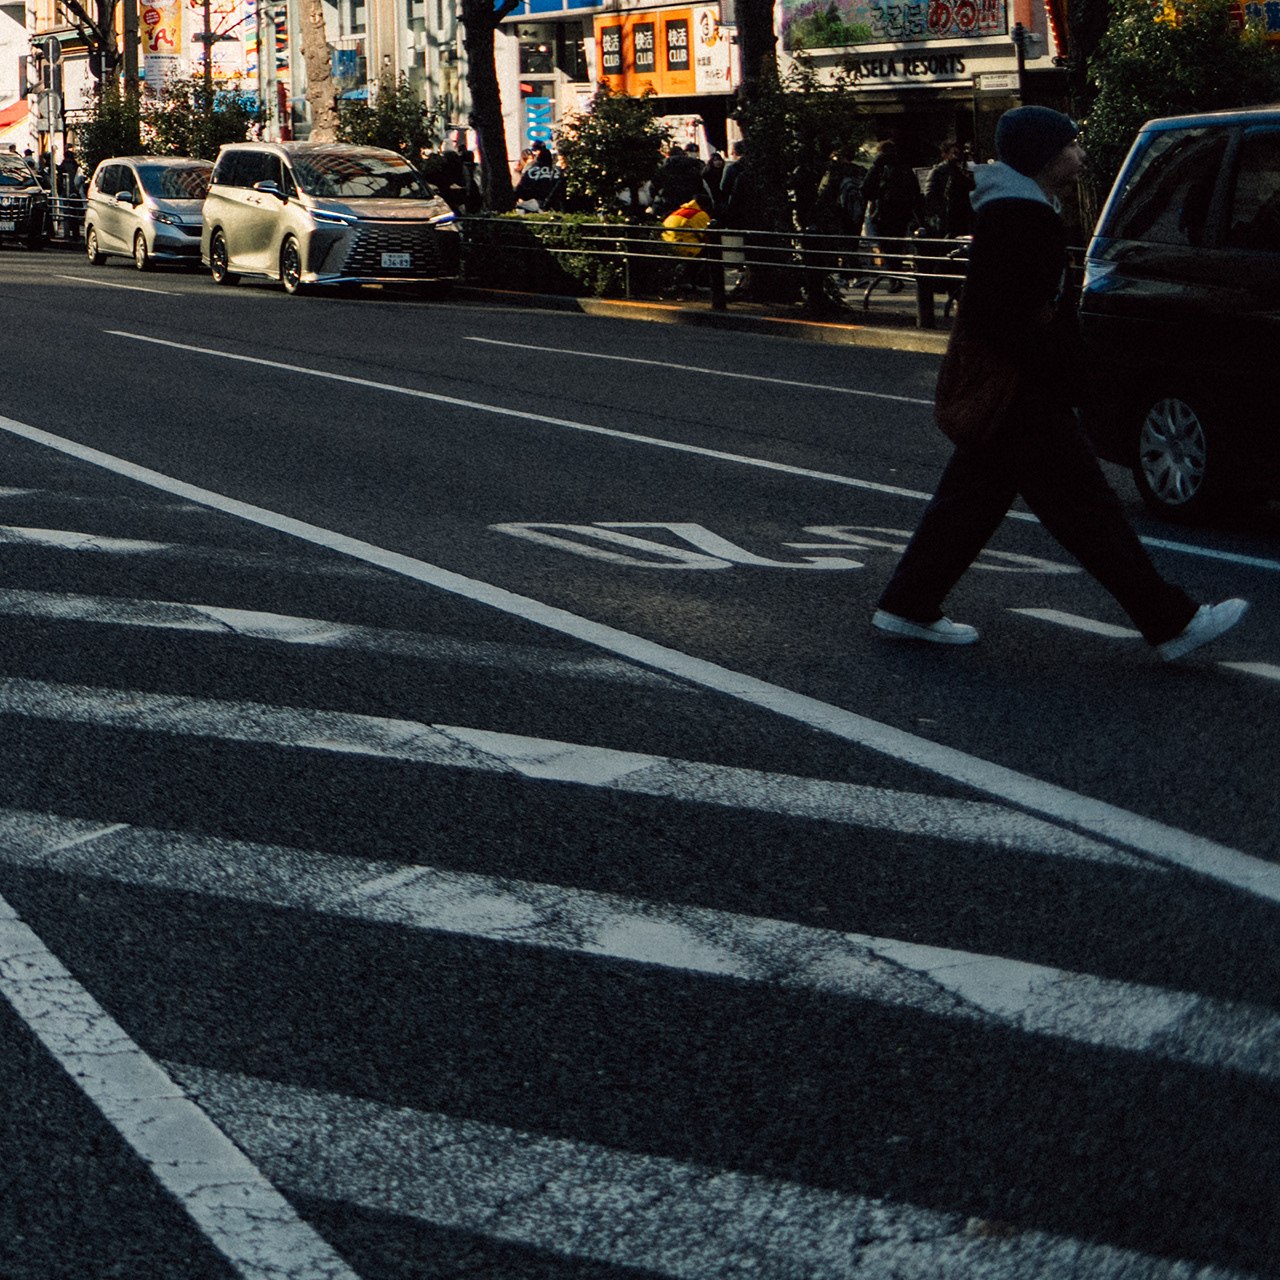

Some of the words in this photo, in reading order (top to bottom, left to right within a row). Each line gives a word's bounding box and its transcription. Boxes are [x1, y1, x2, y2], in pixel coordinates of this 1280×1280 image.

[603, 33, 620, 52] 快活
[635, 31, 654, 50] 快活
[667, 27, 687, 47] 快活
[603, 53, 620, 68] CLUB
[635, 51, 654, 65] CLUB
[668, 48, 688, 63] CLUB
[903, 53, 966, 78] RESORTS
